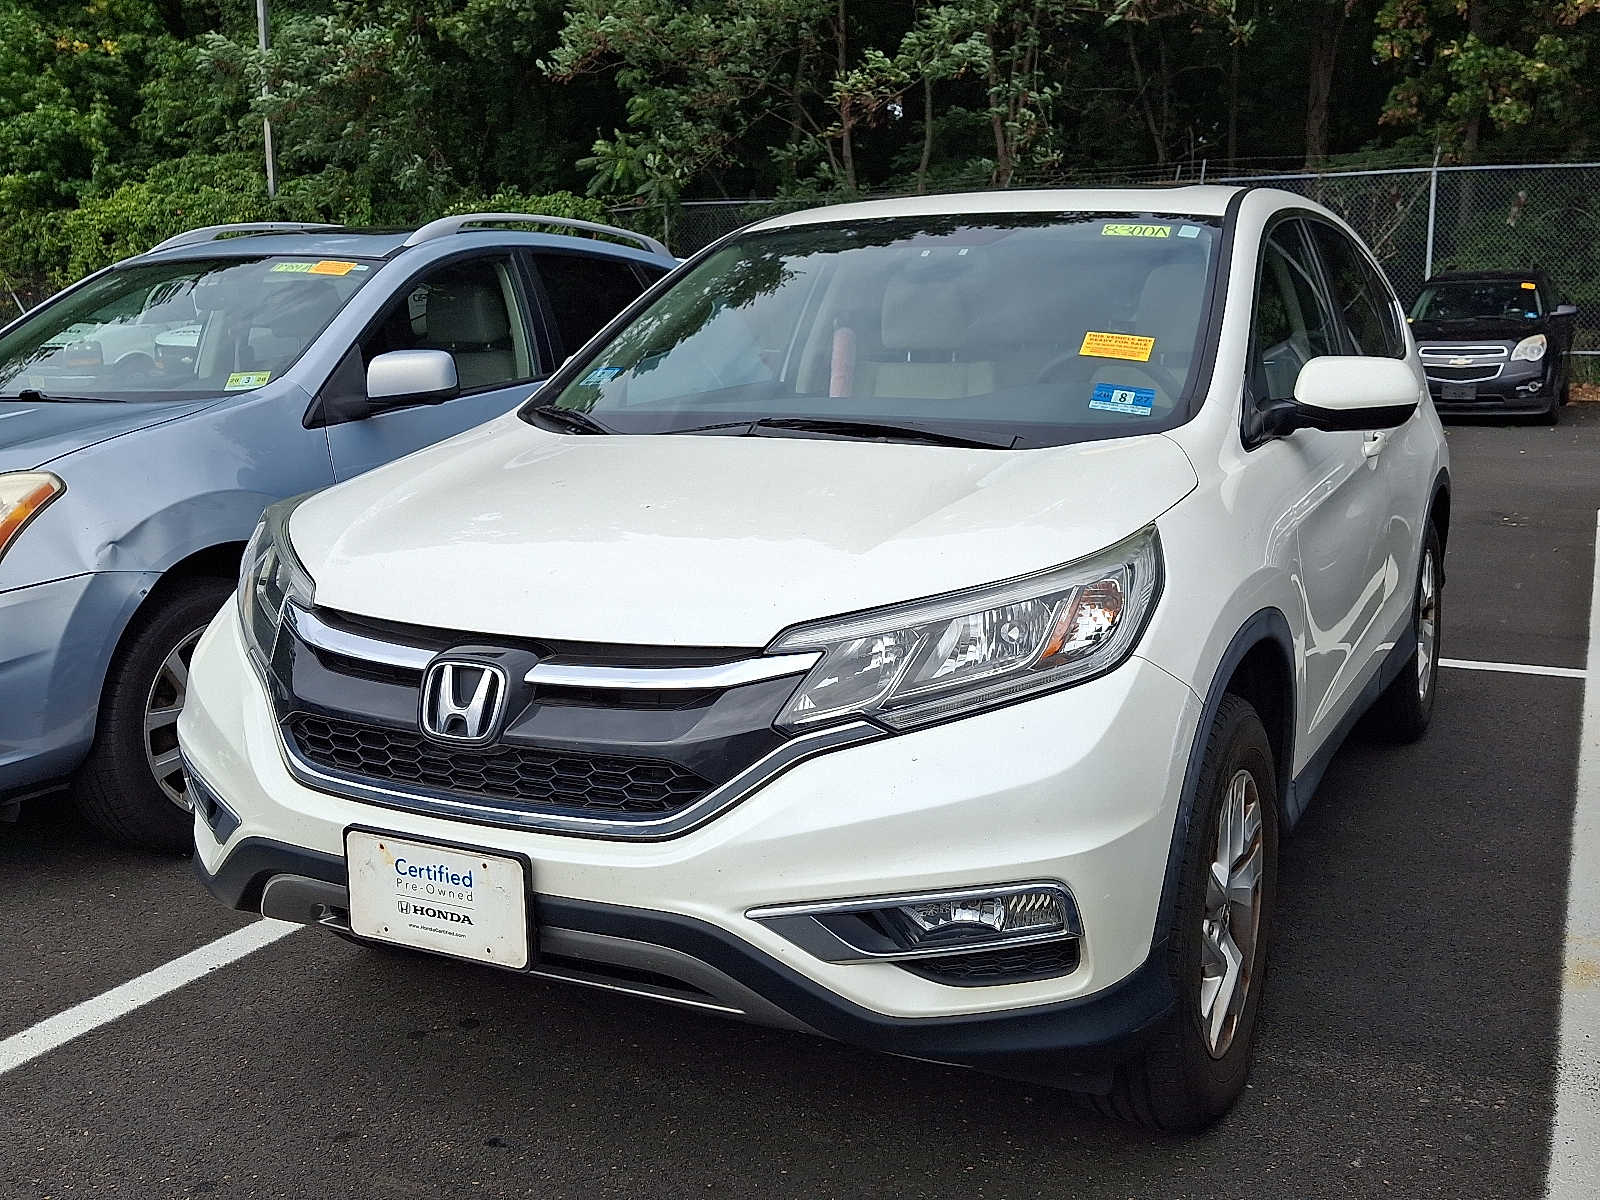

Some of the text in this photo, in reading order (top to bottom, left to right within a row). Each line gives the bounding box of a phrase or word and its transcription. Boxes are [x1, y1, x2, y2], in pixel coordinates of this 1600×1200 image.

[1119, 392, 1128, 402] 8
[395, 858, 473, 888] Certified
[396, 877, 473, 901] Pre-Owned
[412, 905, 474, 925] HONDA
